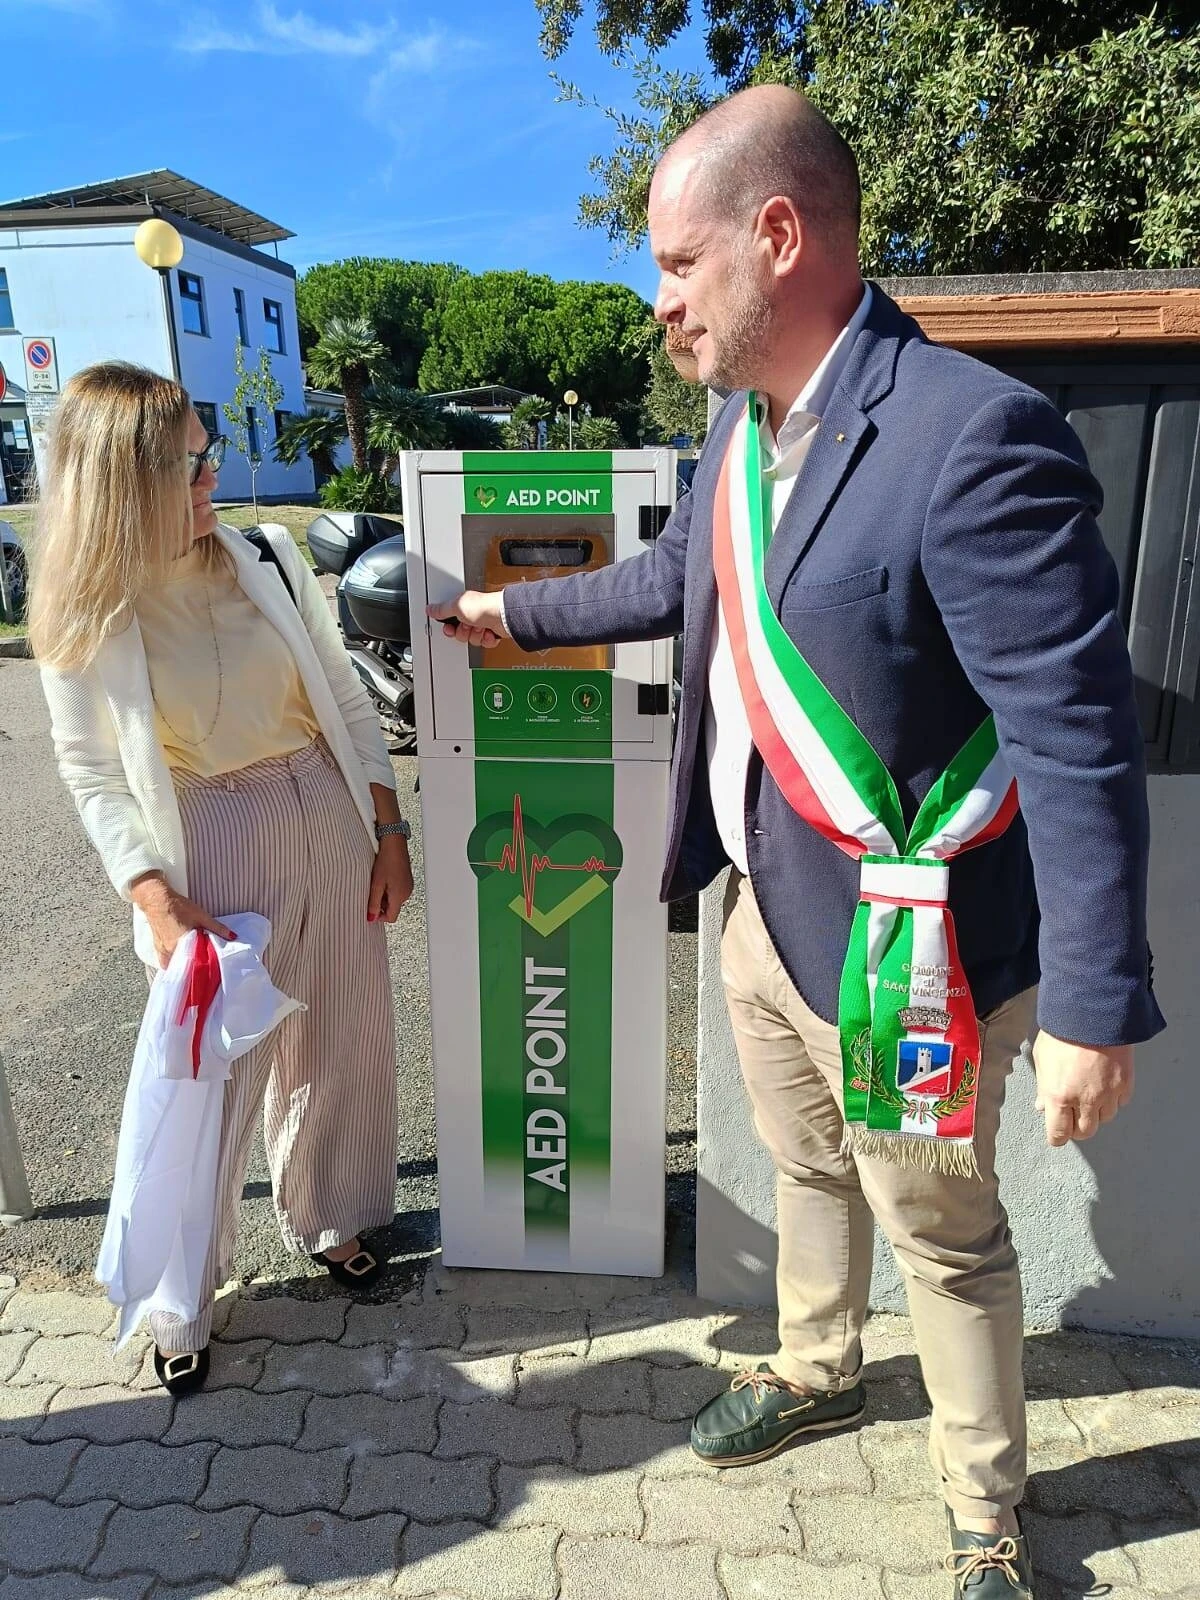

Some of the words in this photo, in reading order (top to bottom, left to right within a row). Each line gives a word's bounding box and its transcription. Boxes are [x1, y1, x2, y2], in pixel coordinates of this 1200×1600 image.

[506, 489, 541, 506] AED
[546, 489, 600, 506] POINT
[901, 963, 955, 977] COMUNE
[882, 979, 908, 993] SAN
[911, 986, 967, 998] VINCENZO
[525, 957, 566, 1095] POINT
[526, 1108, 566, 1192] AED
